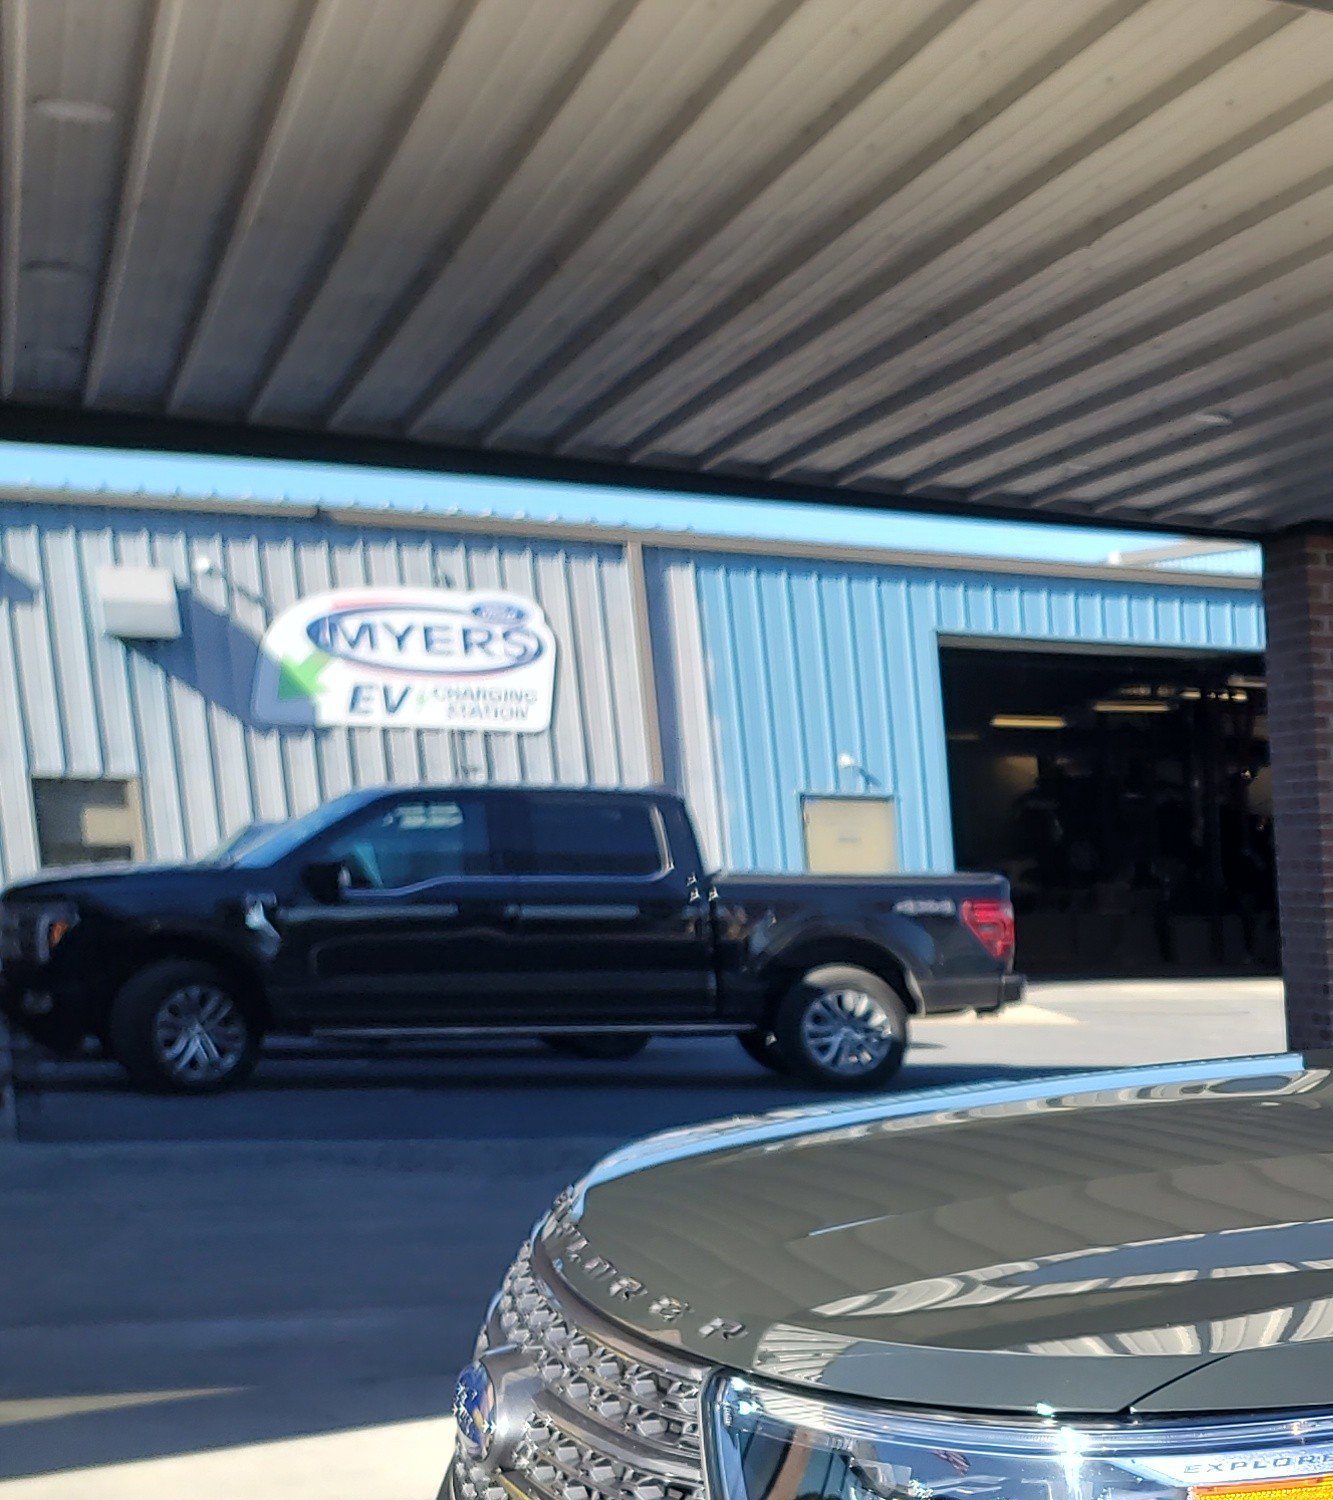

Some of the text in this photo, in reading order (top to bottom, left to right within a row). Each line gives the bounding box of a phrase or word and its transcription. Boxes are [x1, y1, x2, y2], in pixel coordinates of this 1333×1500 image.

[328, 621, 540, 661] MYERS
[350, 684, 411, 714] EV
[432, 686, 537, 703] CHARGING
[448, 704, 529, 720] STATION
